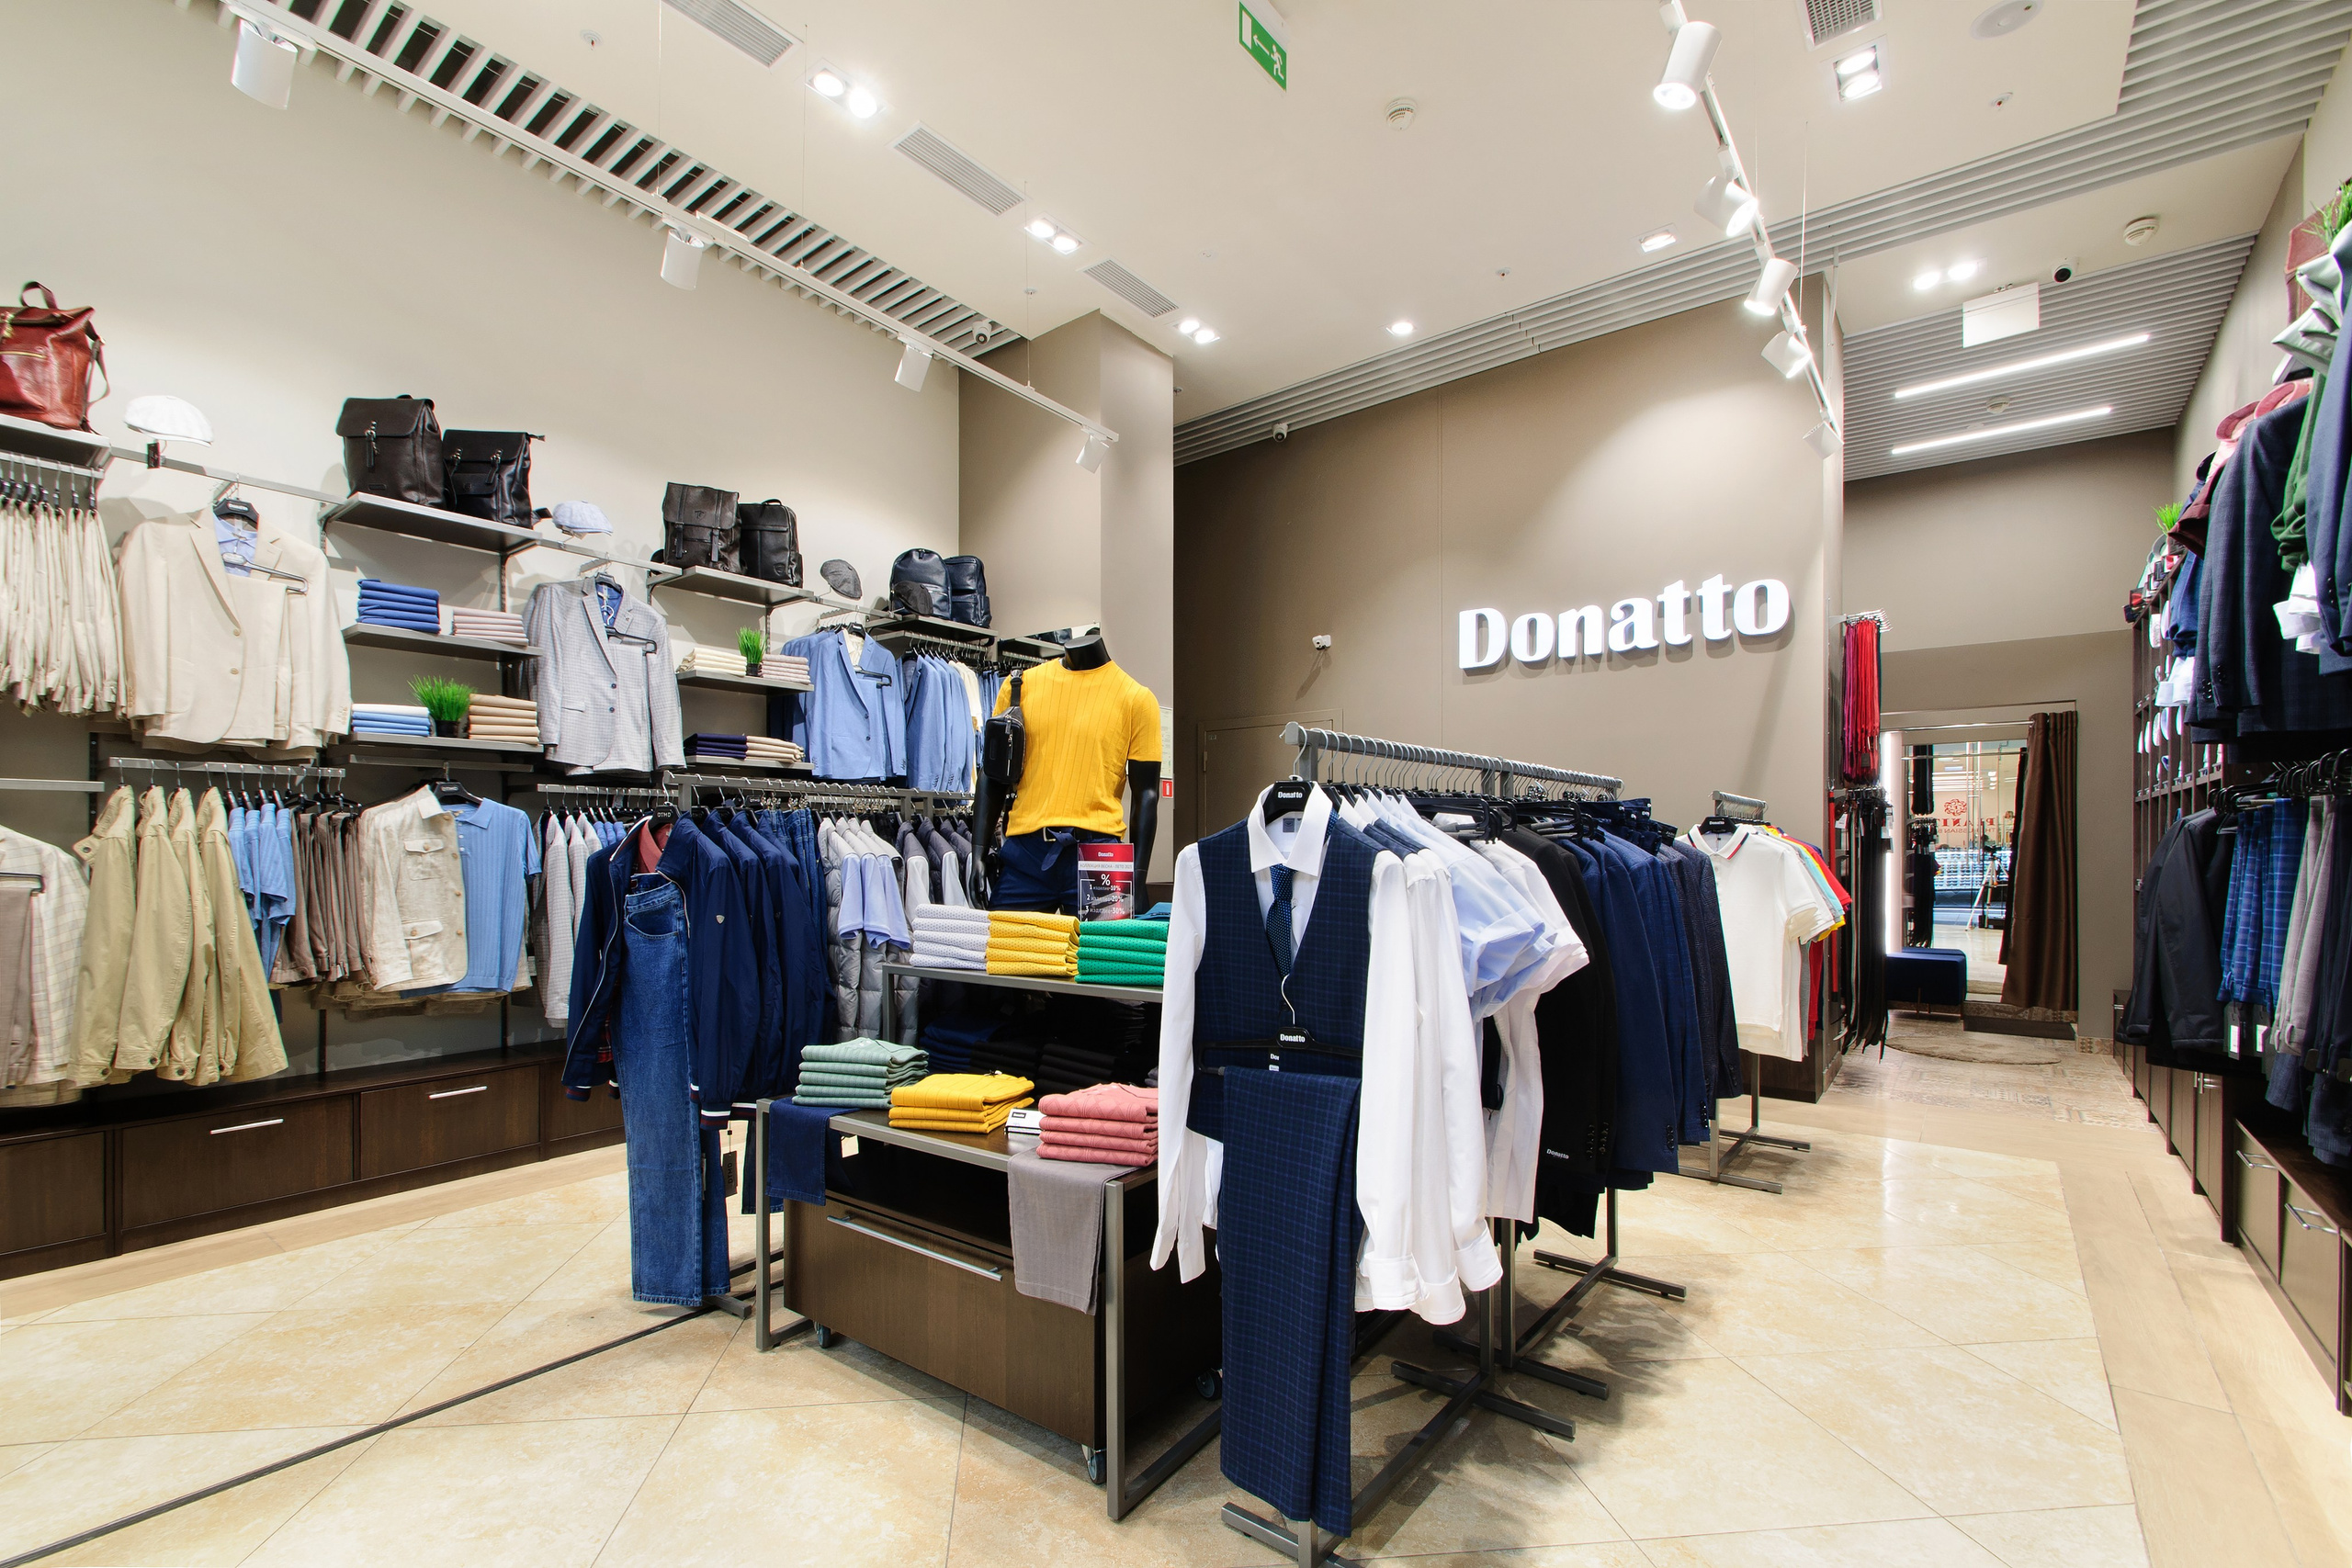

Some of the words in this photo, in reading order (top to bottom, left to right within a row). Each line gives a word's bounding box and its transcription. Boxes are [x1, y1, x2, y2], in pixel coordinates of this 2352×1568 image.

[1458, 573, 1791, 670] Donatto
[1101, 874, 1111, 886] %
[1280, 1033, 1306, 1043] Donatto
